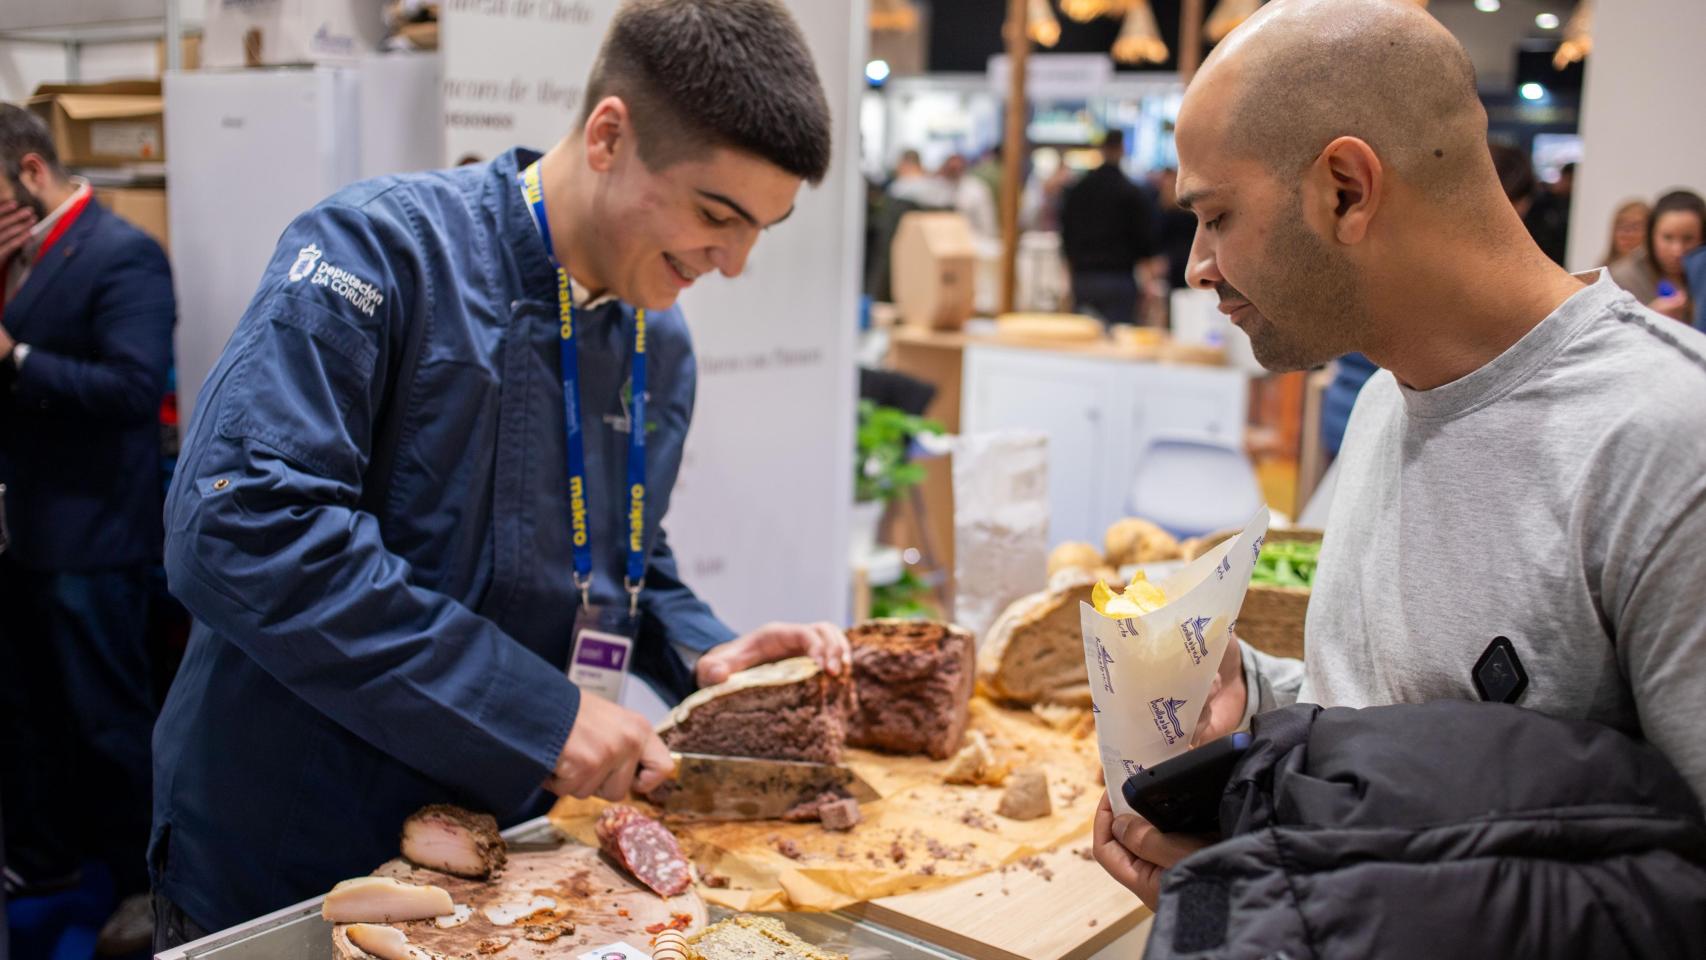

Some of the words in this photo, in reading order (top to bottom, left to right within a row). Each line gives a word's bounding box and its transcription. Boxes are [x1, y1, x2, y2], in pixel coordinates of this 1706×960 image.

[311, 272, 328, 287] DA
[317, 261, 384, 306] Deputación
[557, 267, 572, 340] makro
[570, 475, 587, 547] makro
[629, 483, 644, 552] makro
